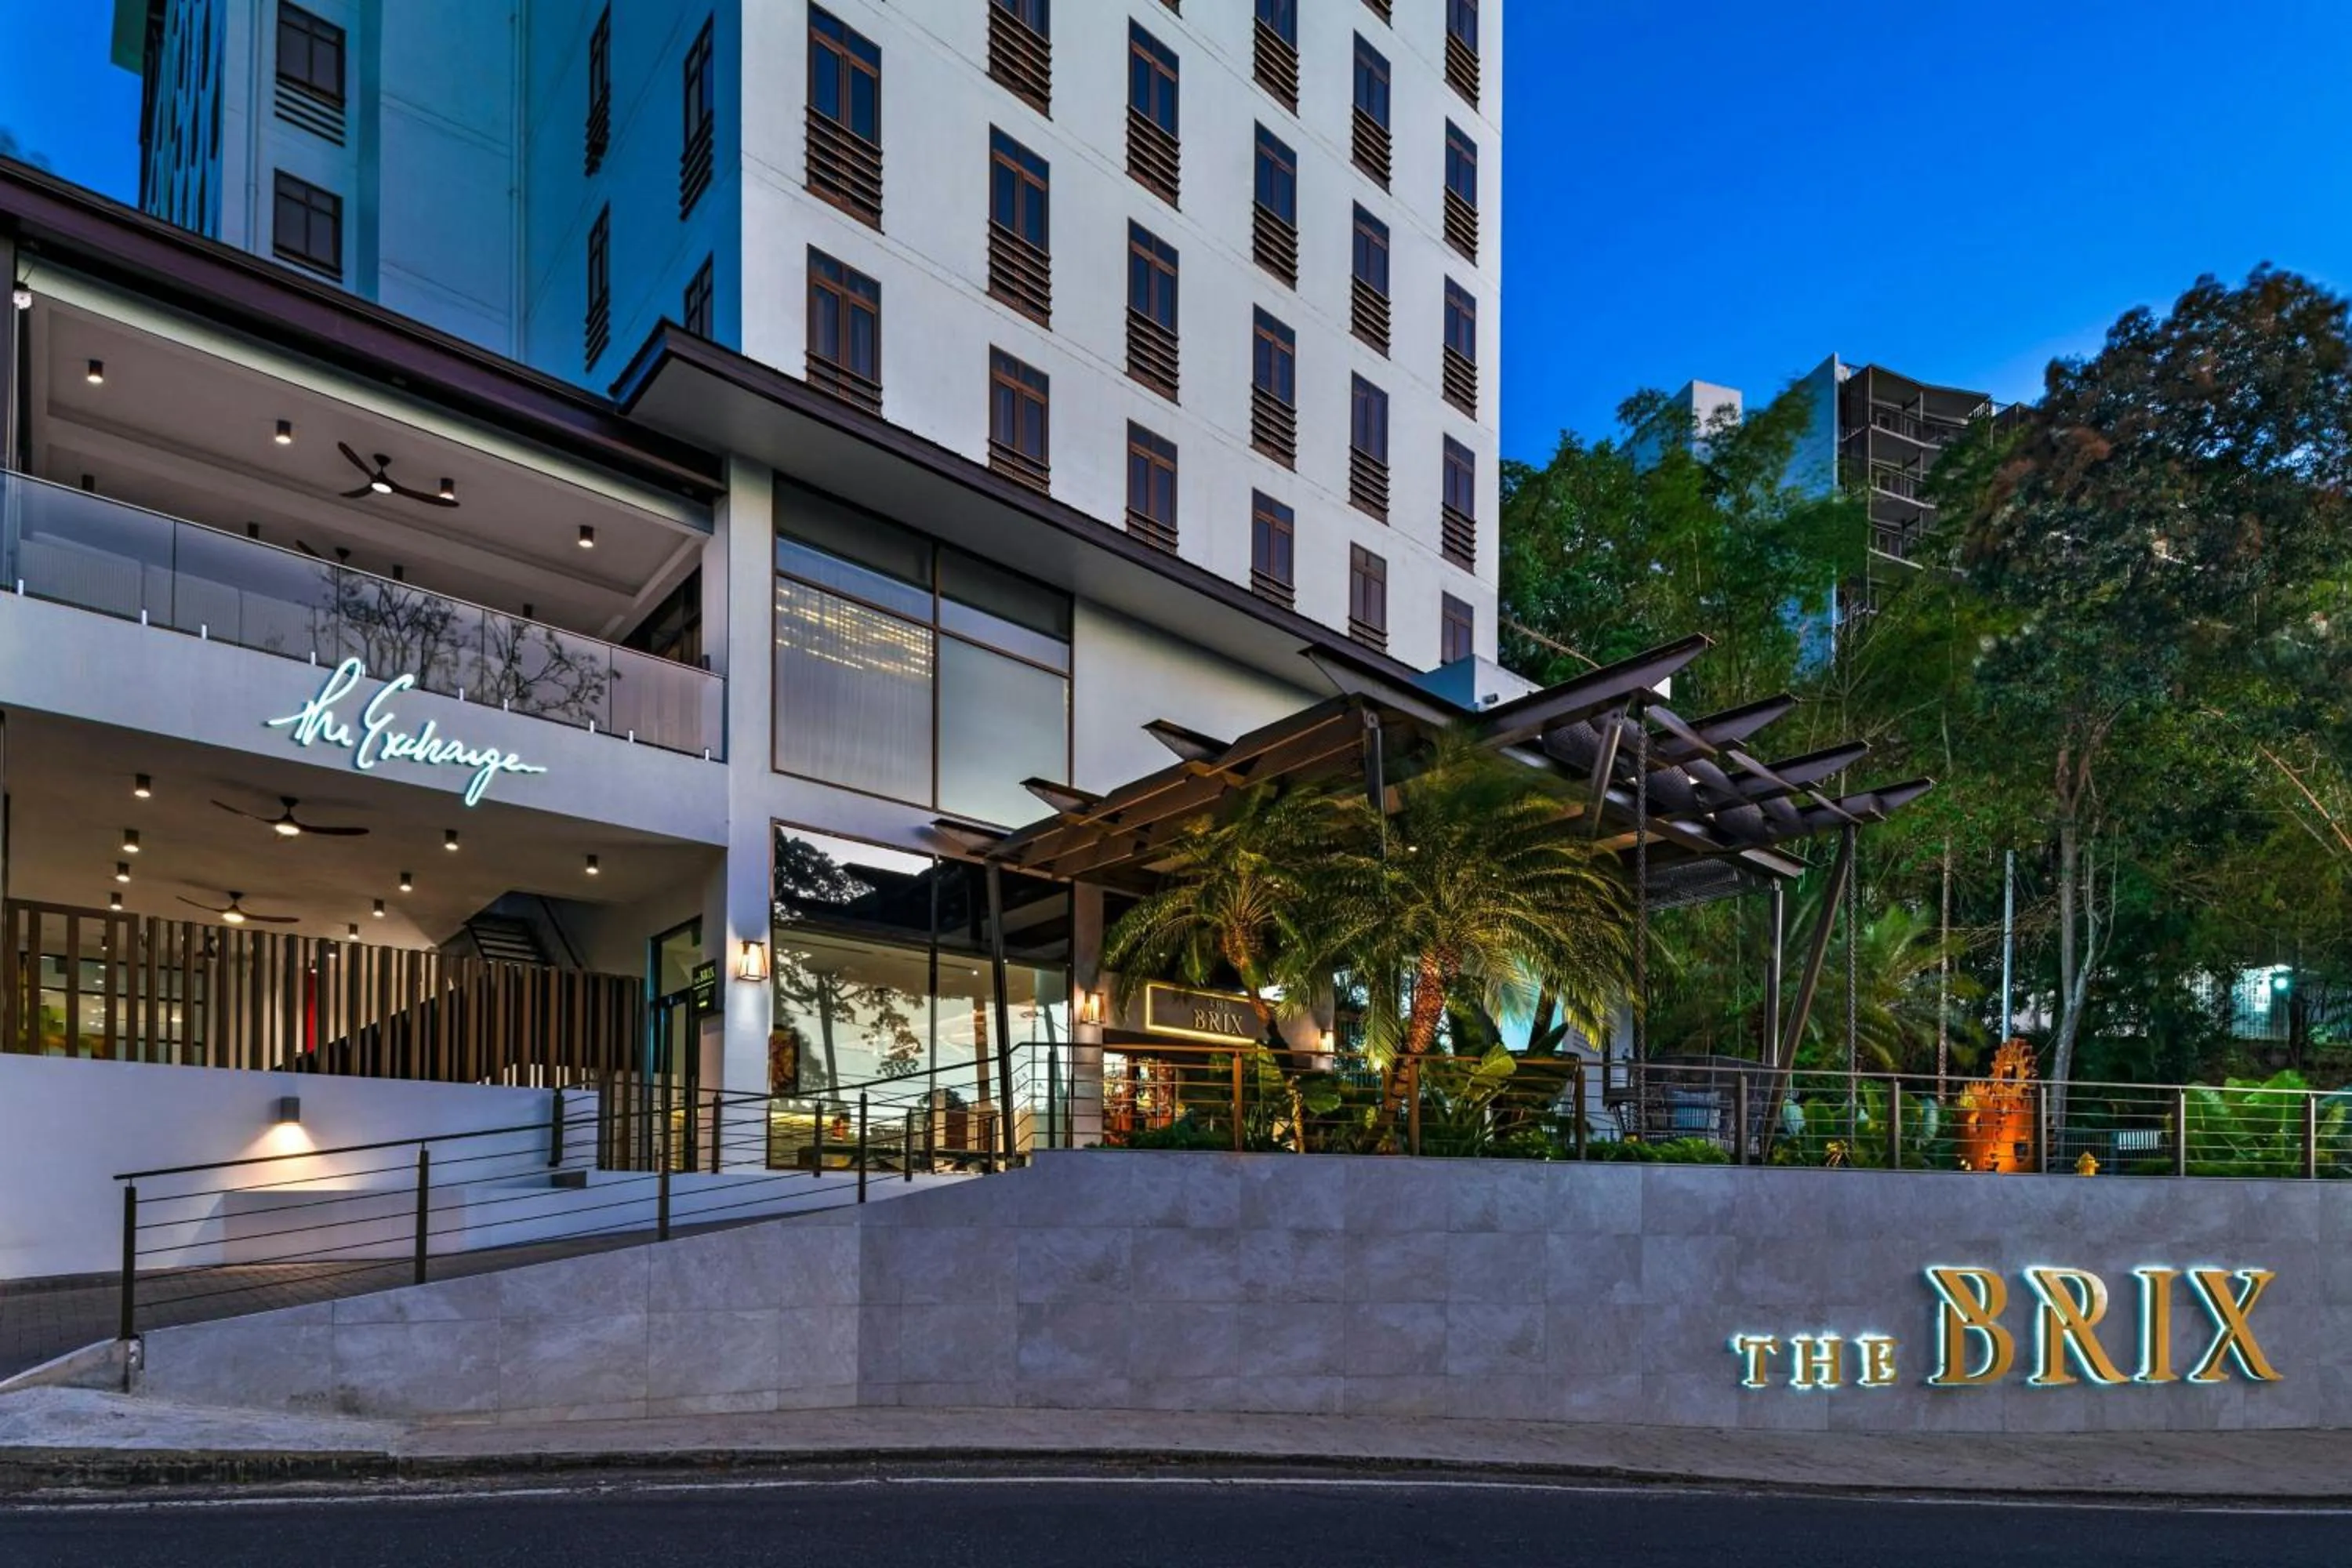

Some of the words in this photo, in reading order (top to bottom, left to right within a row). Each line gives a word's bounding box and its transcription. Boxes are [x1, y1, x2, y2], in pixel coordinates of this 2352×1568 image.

[357, 673, 547, 806] Exchange
[1193, 1009, 1243, 1035] BRIX
[1731, 1334, 1899, 1388] THE
[1926, 1265, 2283, 1385] BRIX
